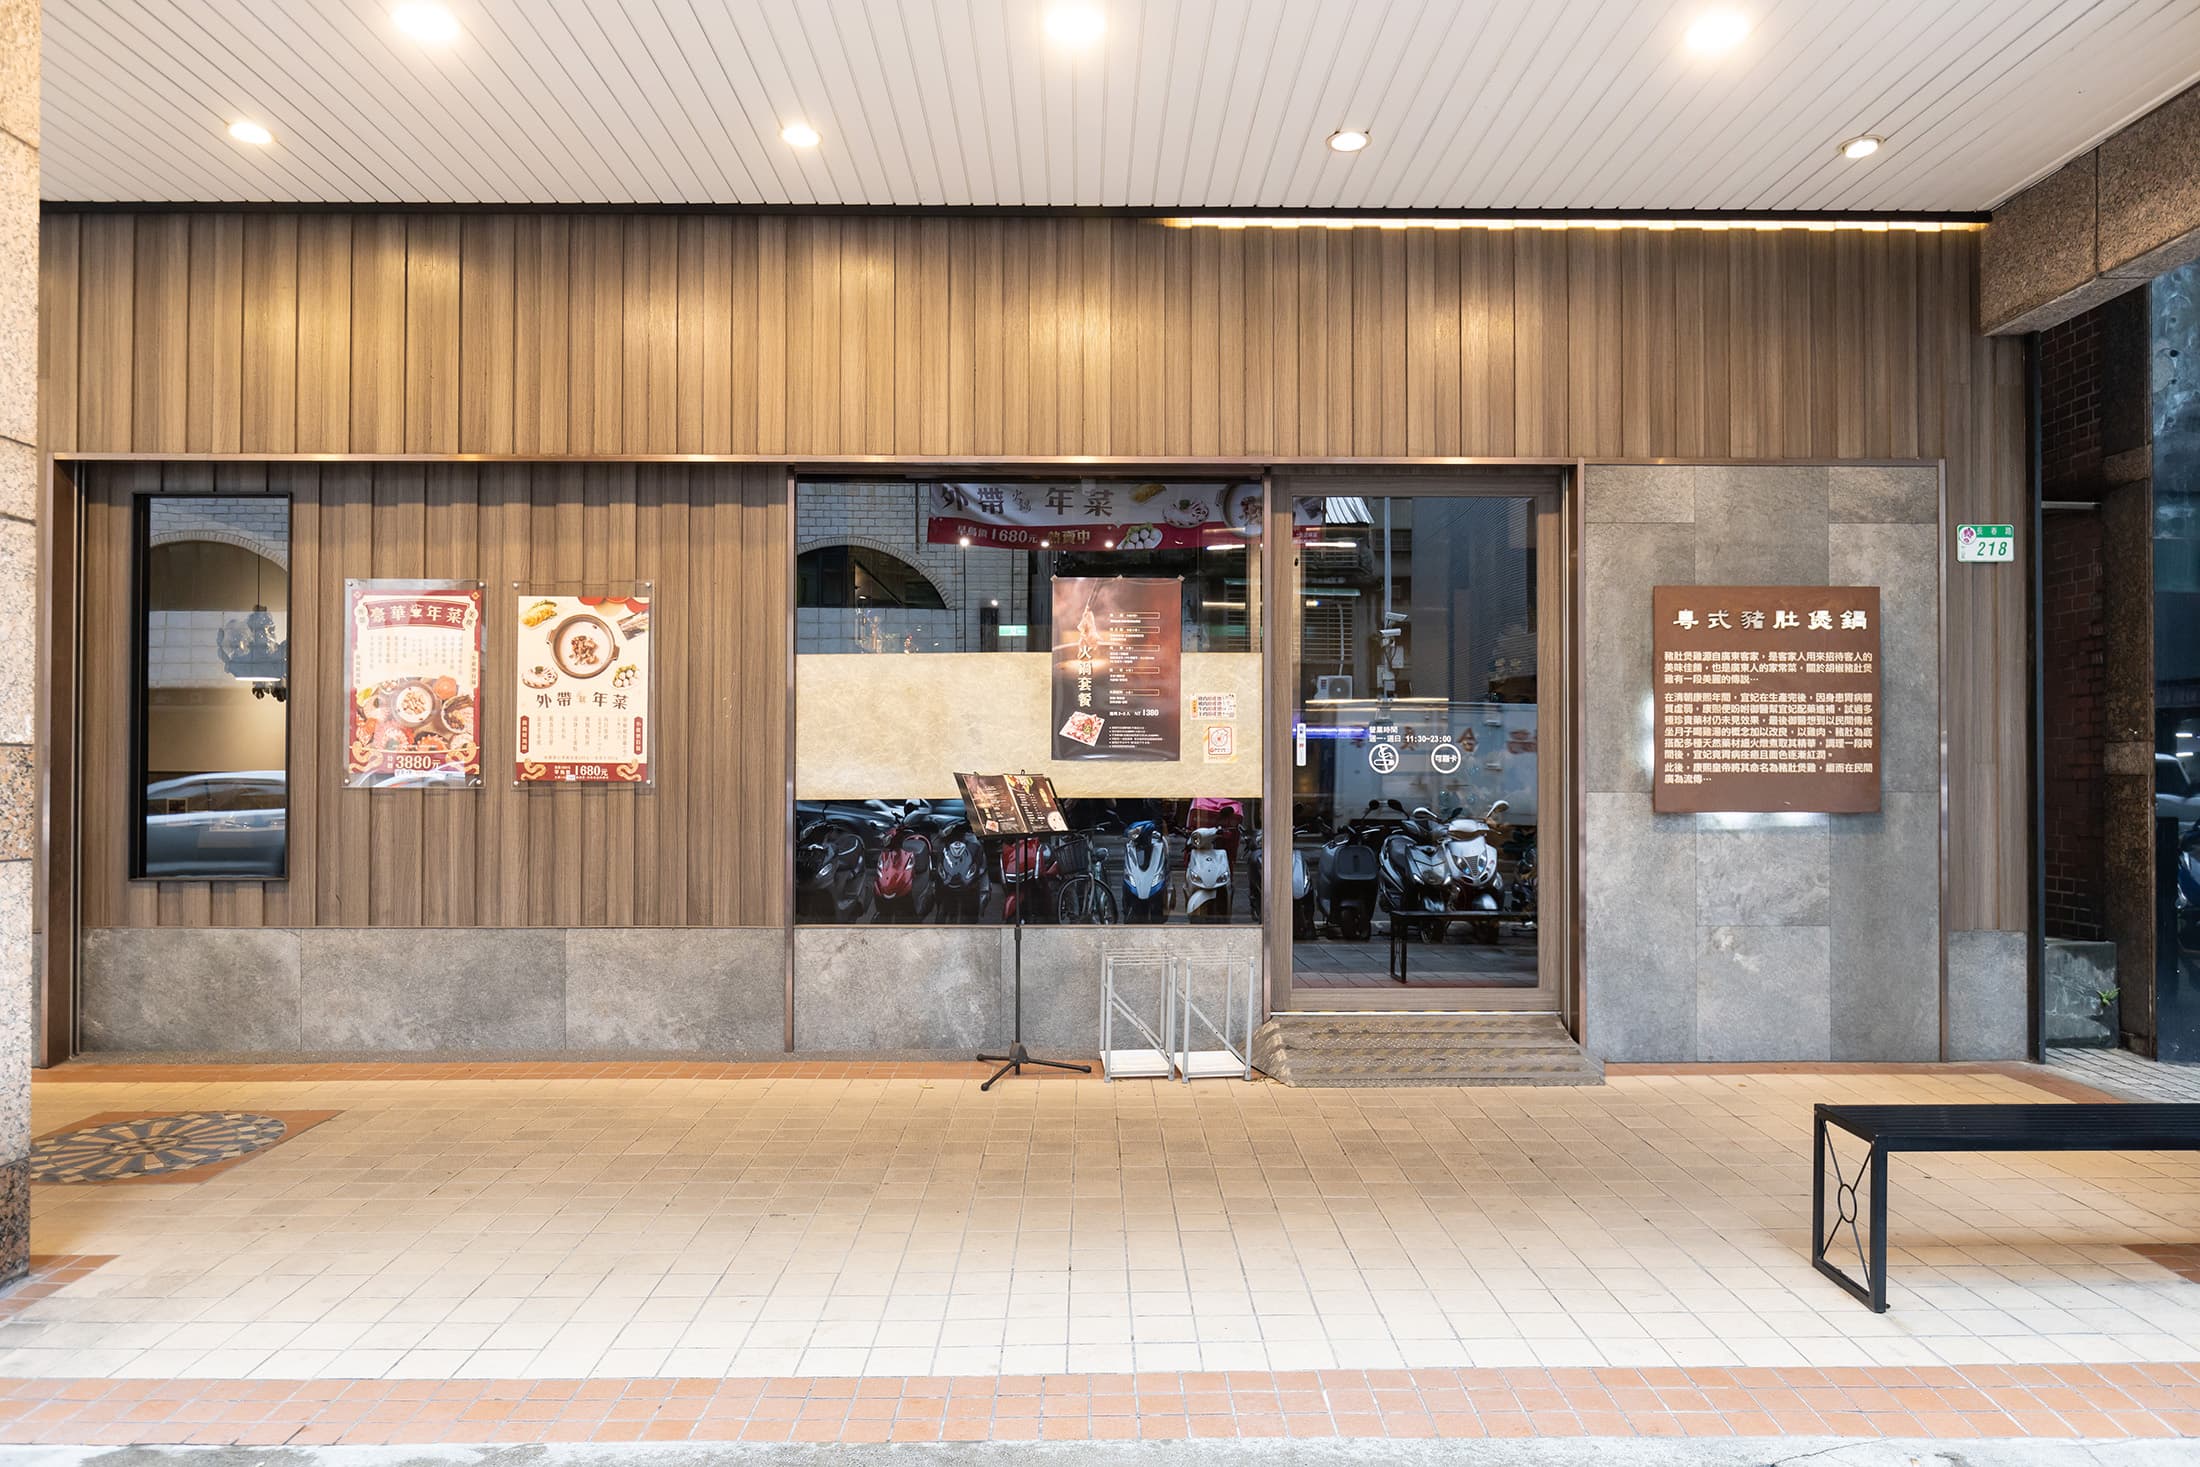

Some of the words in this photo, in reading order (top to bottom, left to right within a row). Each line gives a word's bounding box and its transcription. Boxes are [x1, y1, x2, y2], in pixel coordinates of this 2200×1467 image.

[941, 487, 1004, 514] 外帶
[1045, 487, 1115, 517] 年菜
[1977, 541, 2008, 556] 218
[426, 605, 463, 624] 年菜
[1077, 645, 1092, 707] 火鍋套餐
[536, 691, 572, 708] 外帶
[592, 691, 629, 710] 年菜
[574, 765, 609, 776] 1680元
